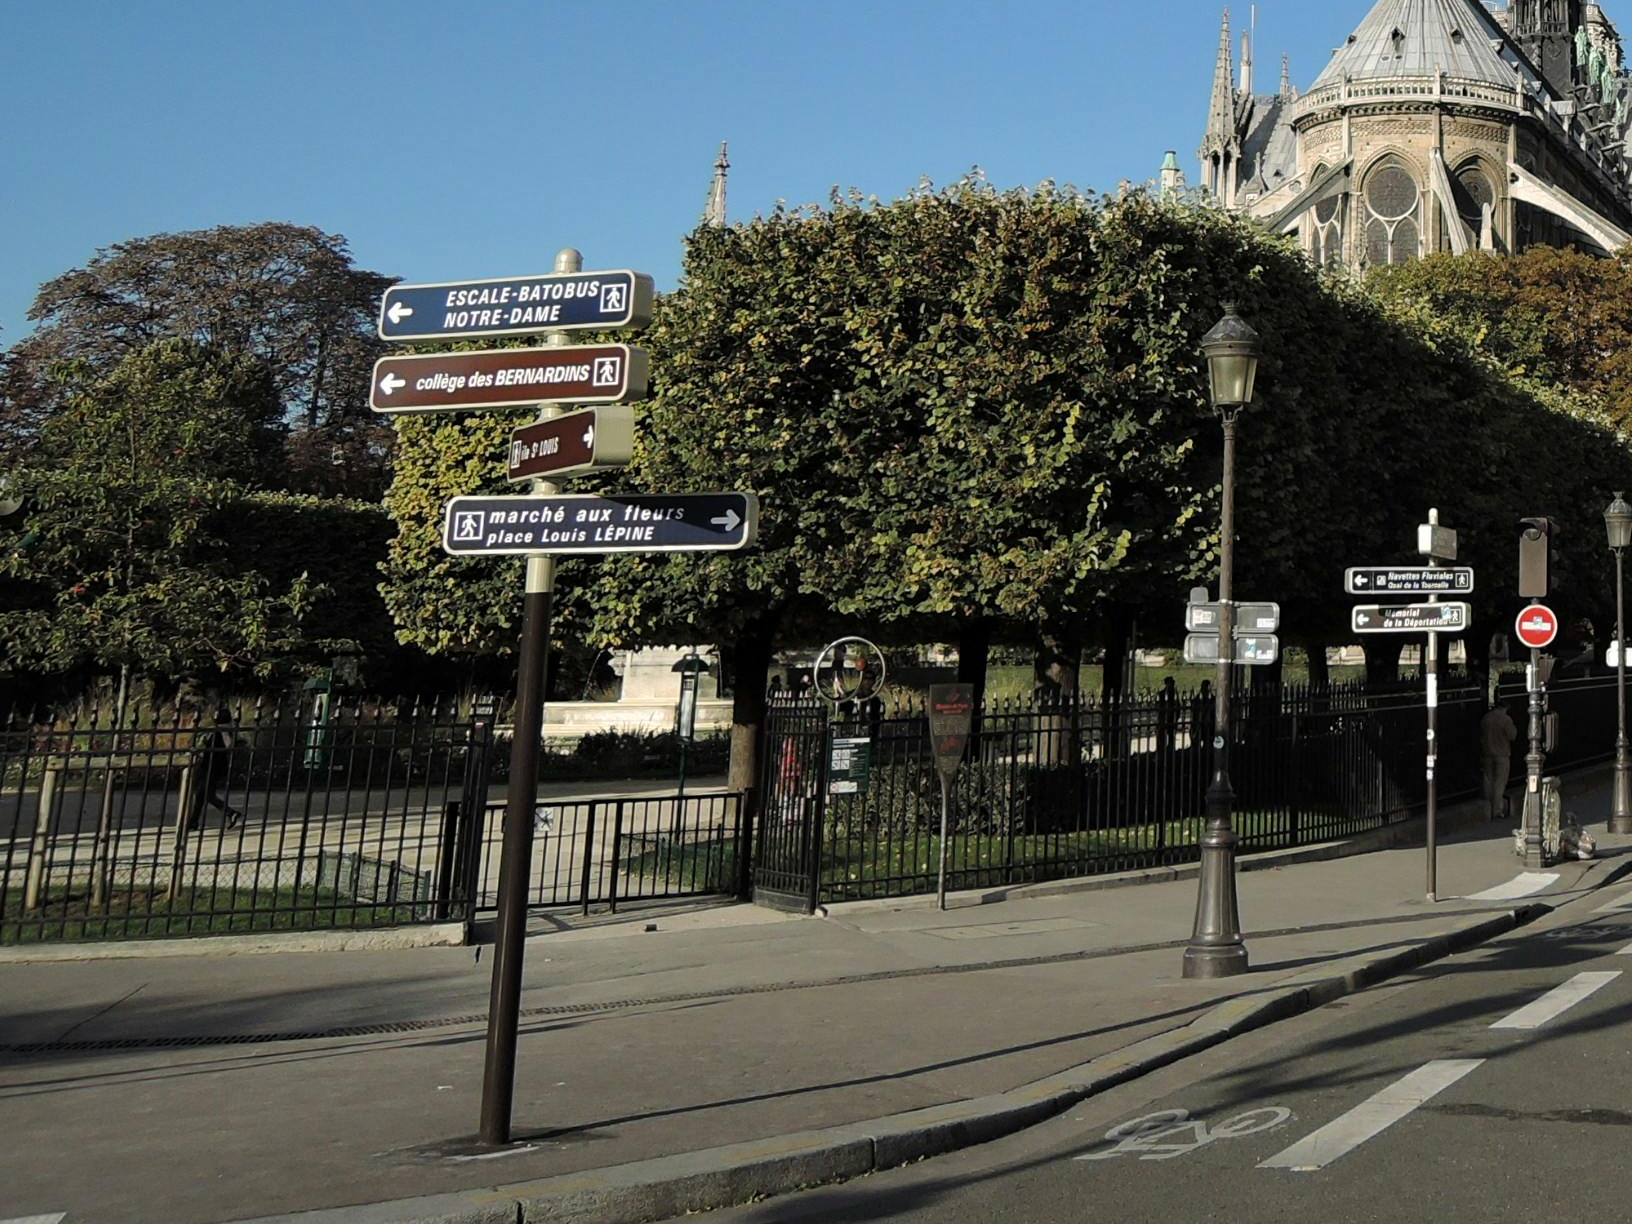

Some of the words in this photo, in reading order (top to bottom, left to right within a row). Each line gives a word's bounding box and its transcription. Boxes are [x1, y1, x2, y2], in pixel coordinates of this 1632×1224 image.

[446, 281, 600, 307] ESCALE-BATOBUS
[444, 305, 561, 328] NOTRE-DAME
[416, 374, 465, 393] collège
[468, 371, 492, 387] des
[495, 365, 590, 386] BERNARDINS
[539, 436, 559, 457] LOUIS
[489, 505, 565, 524] marché
[576, 508, 612, 522] aux
[624, 504, 685, 522] fleurs
[486, 529, 533, 547] place
[541, 528, 587, 543] Louis
[595, 524, 655, 542] LÉPINE
[1384, 619, 1393, 627] de
[1394, 618, 1402, 627] la
